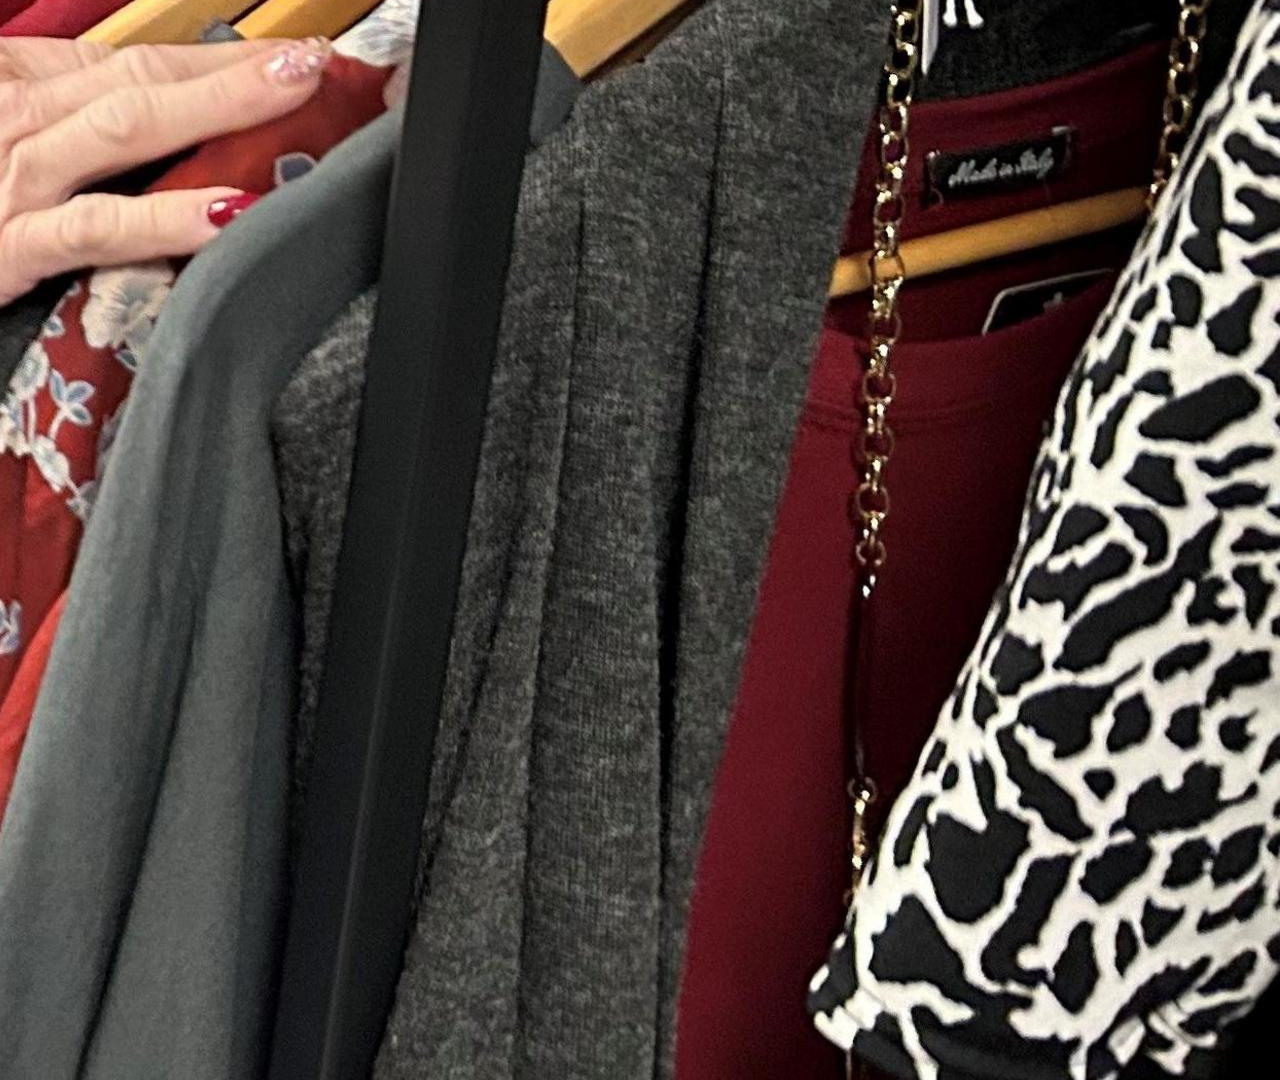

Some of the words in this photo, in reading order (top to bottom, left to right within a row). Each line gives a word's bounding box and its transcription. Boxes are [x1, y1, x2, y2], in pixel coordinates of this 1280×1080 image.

[948, 158, 997, 187] Made
[998, 163, 1014, 178] in
[1015, 147, 1054, 179] Italy
